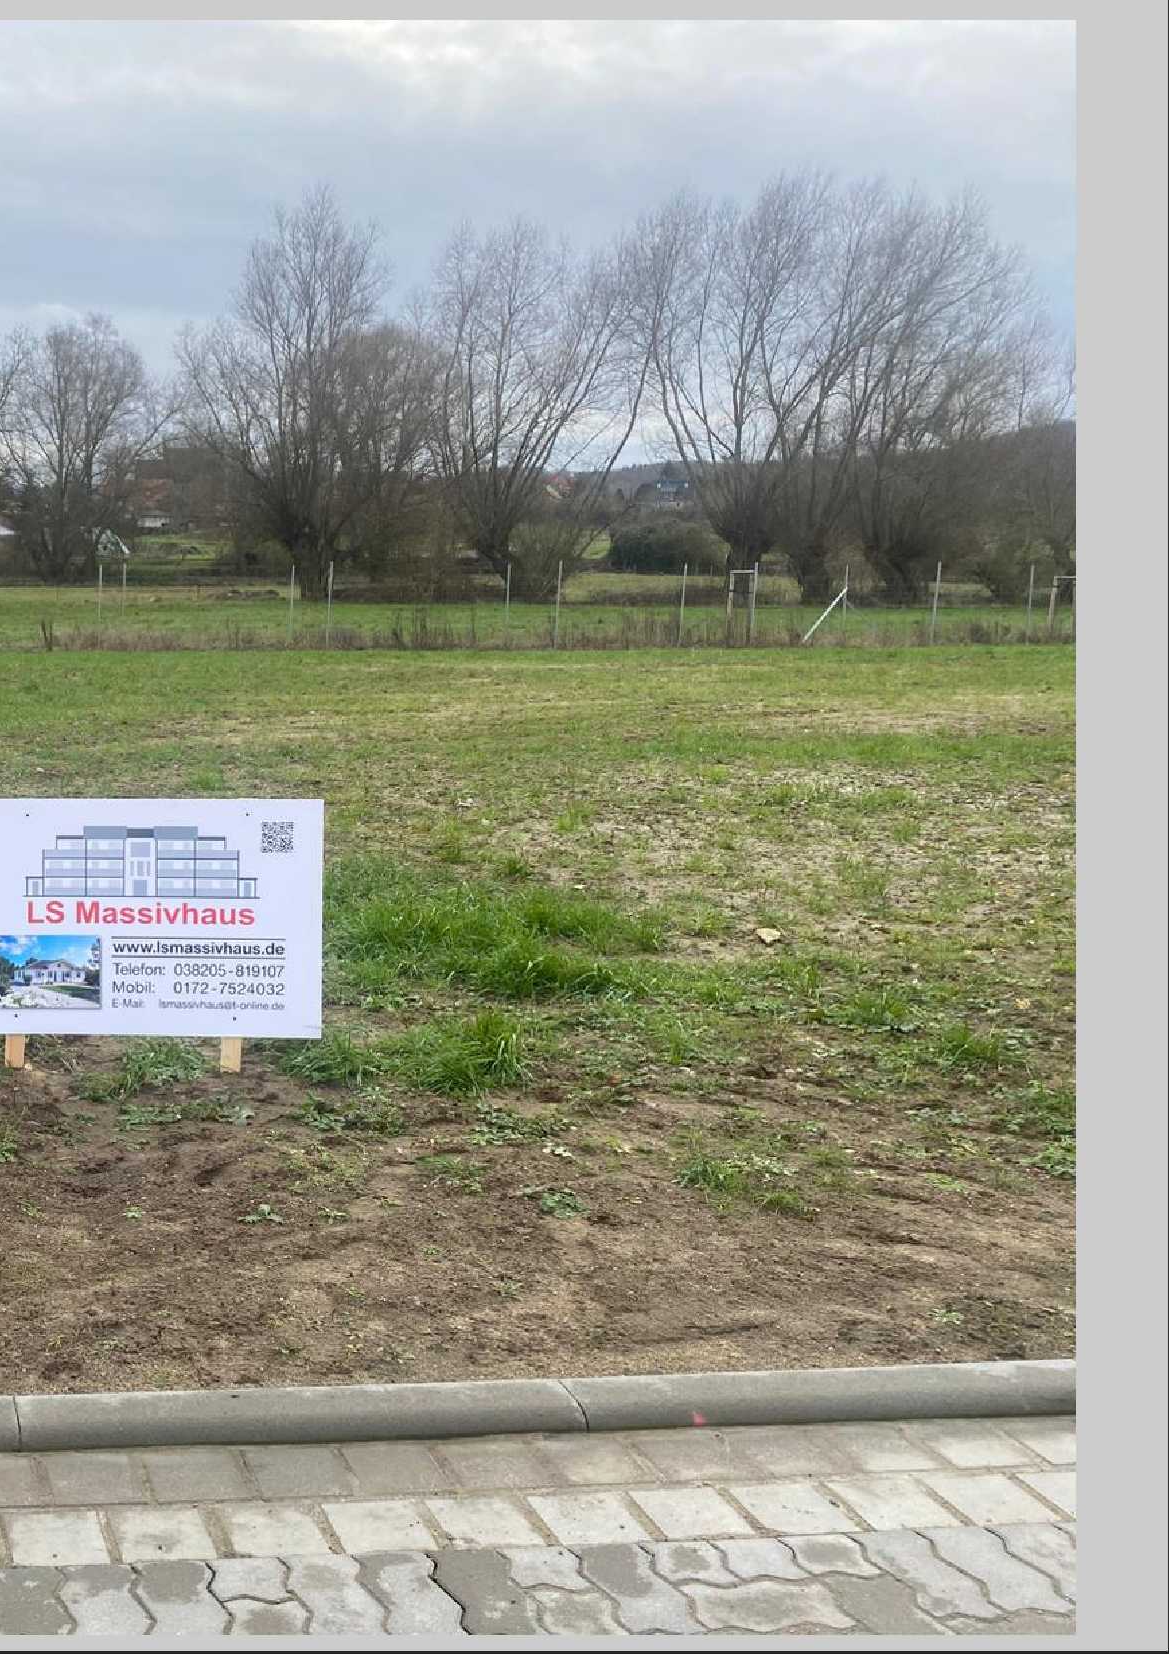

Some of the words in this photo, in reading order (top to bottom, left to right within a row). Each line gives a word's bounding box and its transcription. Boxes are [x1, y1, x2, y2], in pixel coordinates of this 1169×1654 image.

[28, 900, 64, 924] LS
[76, 901, 255, 925] Massivhaus
[112, 941, 286, 956] www.lsmassivhaus.de
[113, 962, 166, 976] Telefon:
[112, 981, 155, 994] Mobil:
